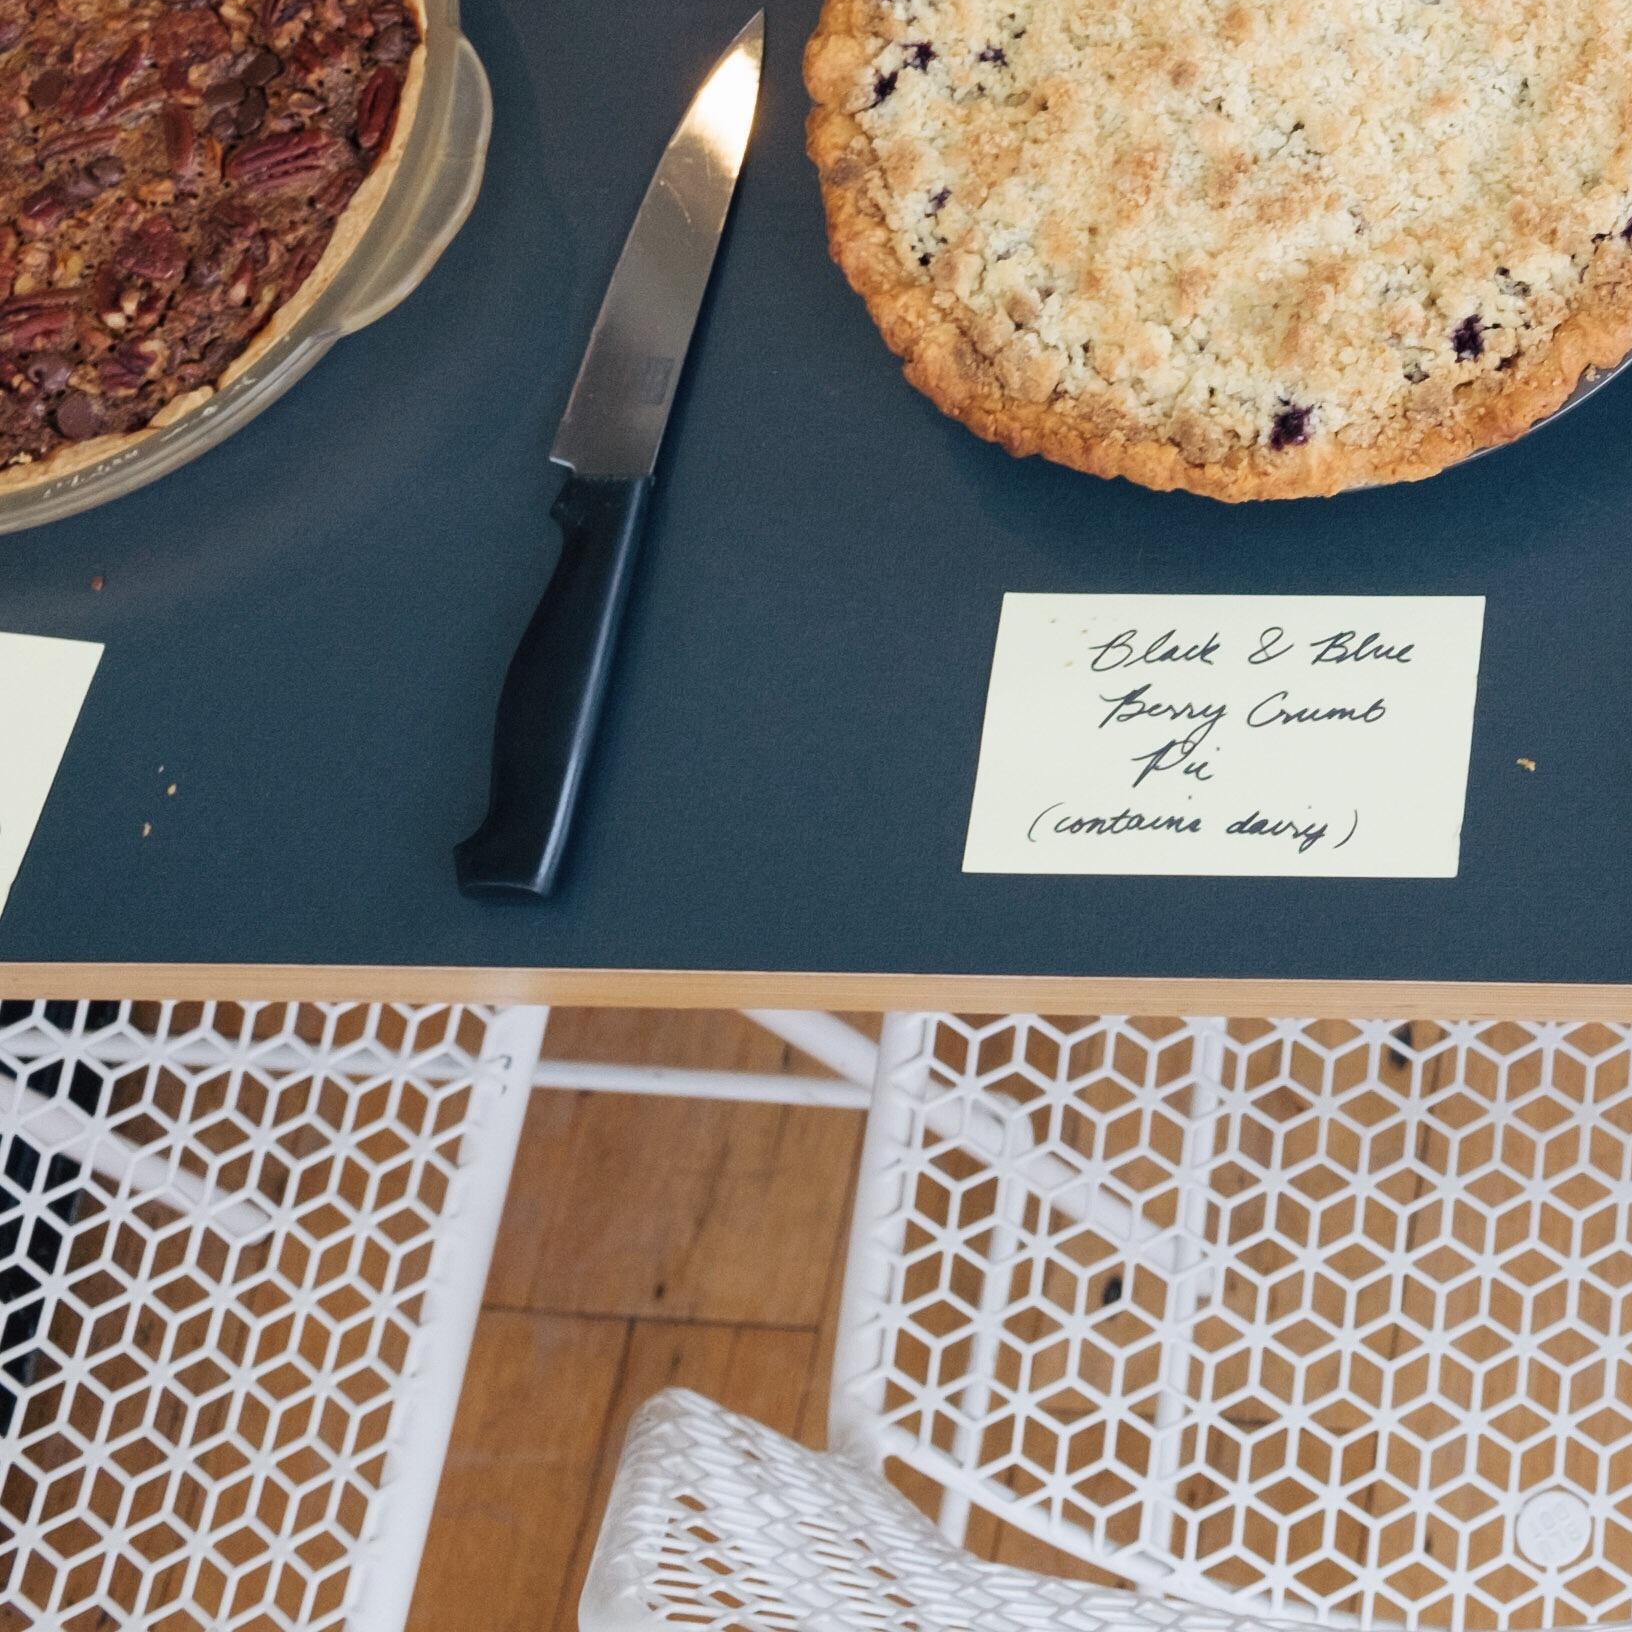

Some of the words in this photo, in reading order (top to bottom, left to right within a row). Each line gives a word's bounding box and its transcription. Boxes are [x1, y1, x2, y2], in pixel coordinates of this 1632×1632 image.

[1089, 629, 1220, 672] Black
[1247, 626, 1294, 665] &
[1310, 629, 1415, 665] Blue
[1098, 682, 1227, 743] Berry
[1246, 691, 1386, 728] Crumb
